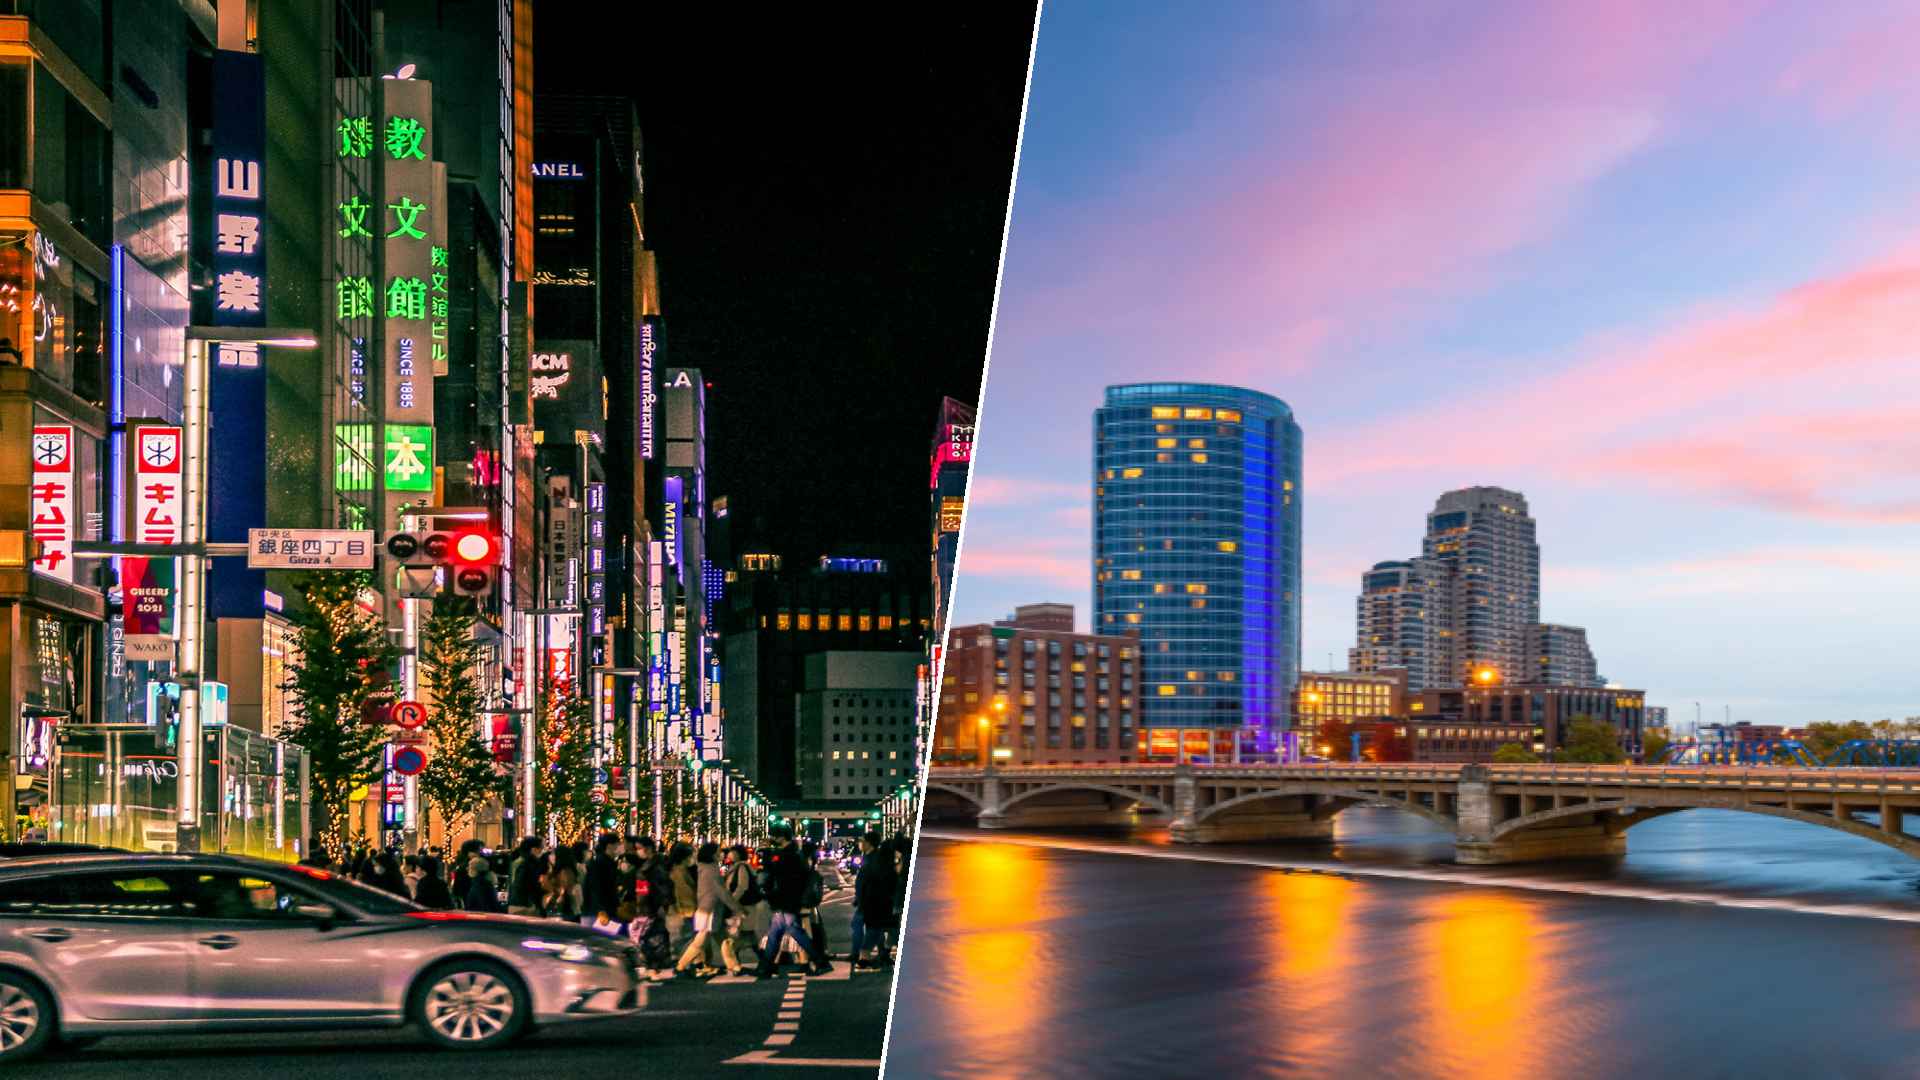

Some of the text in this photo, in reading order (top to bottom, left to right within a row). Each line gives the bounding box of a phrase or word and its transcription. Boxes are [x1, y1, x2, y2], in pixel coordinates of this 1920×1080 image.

[385, 115, 428, 320] 教文館
[401, 338, 414, 408] SINCE 1885
[387, 436, 426, 481] 本
[258, 530, 291, 538] 中央区
[258, 539, 364, 555] 銀座四丁目
[289, 555, 332, 564] Ginza 4
[137, 604, 162, 612] 2021
[133, 643, 168, 651] WAKO
